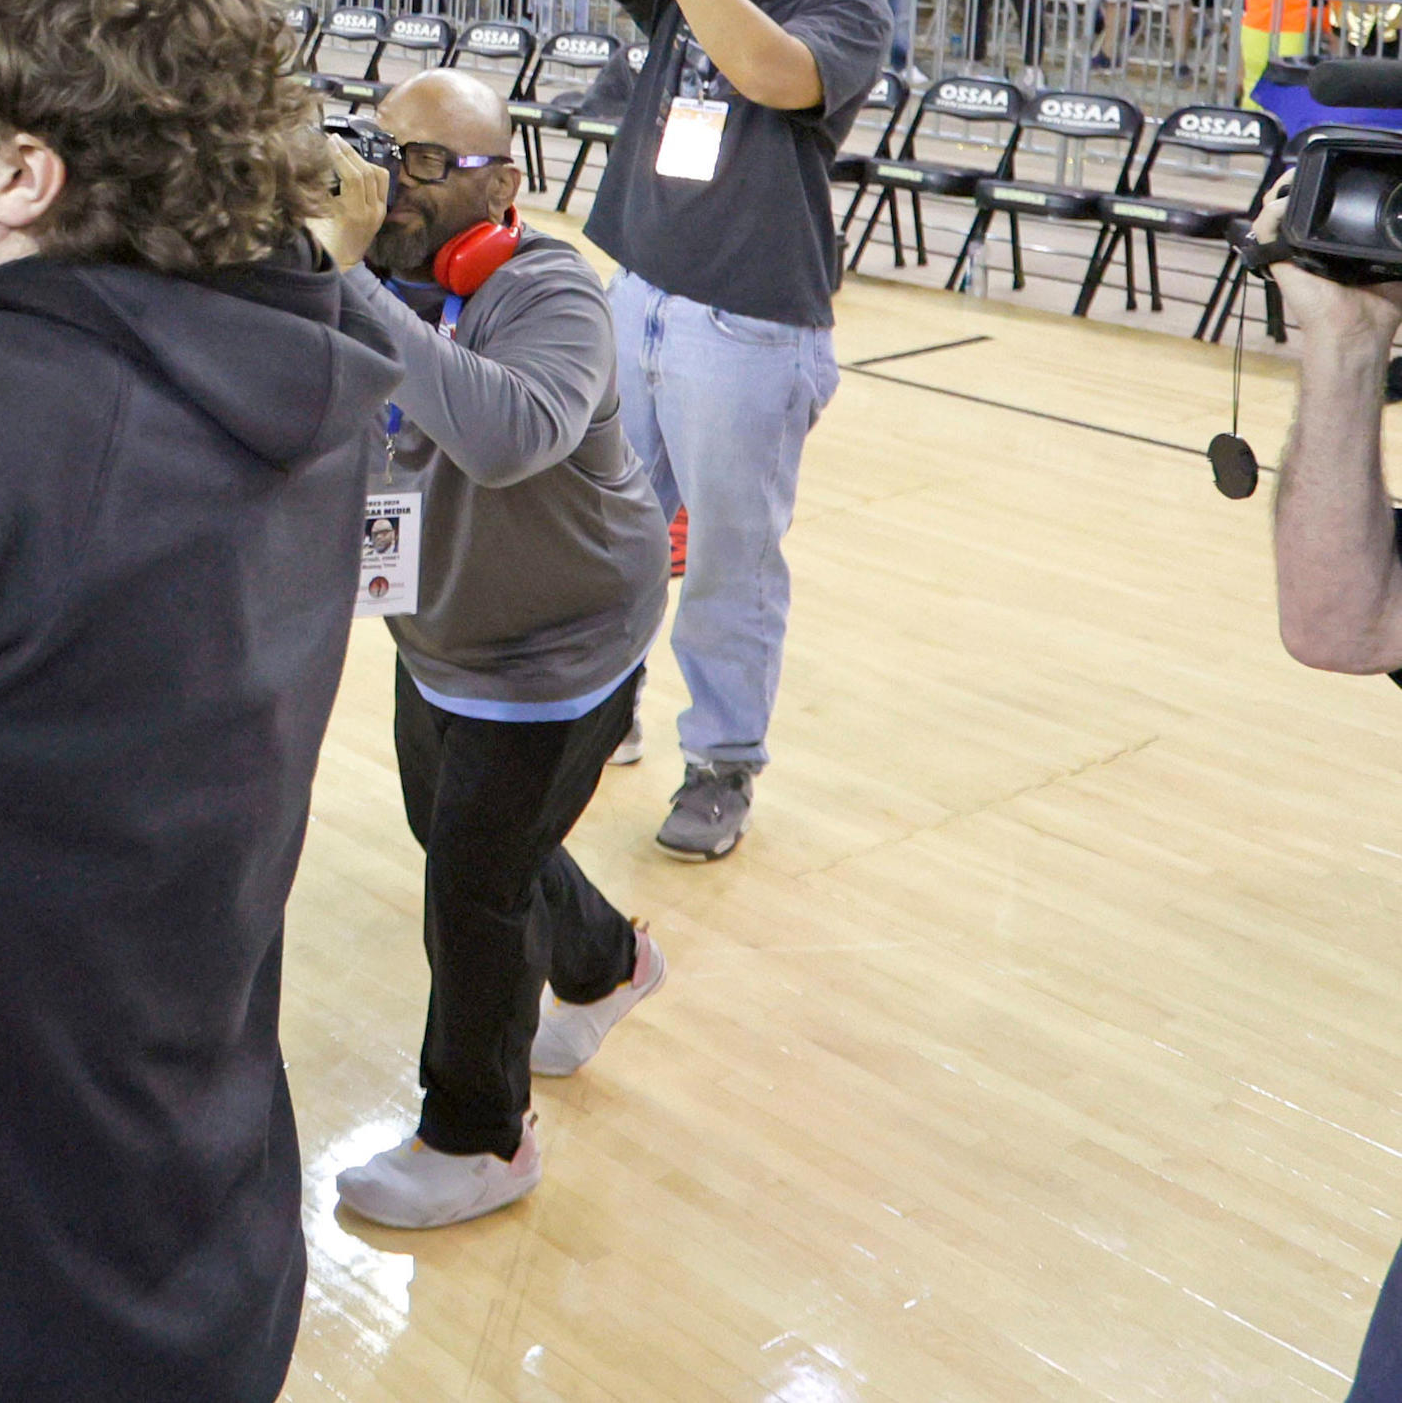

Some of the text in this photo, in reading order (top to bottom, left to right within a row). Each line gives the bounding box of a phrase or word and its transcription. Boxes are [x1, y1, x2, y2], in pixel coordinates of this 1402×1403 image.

[332, 12, 377, 29] OSSAA
[394, 19, 441, 38] OSSAA
[470, 28, 520, 46] OSSAA
[555, 37, 610, 55] OSSAA
[939, 83, 1009, 107] OSSAA
[1039, 99, 1121, 123] OSSAA
[1178, 113, 1262, 139] OSSAA
[383, 507, 411, 516] MEDIA
